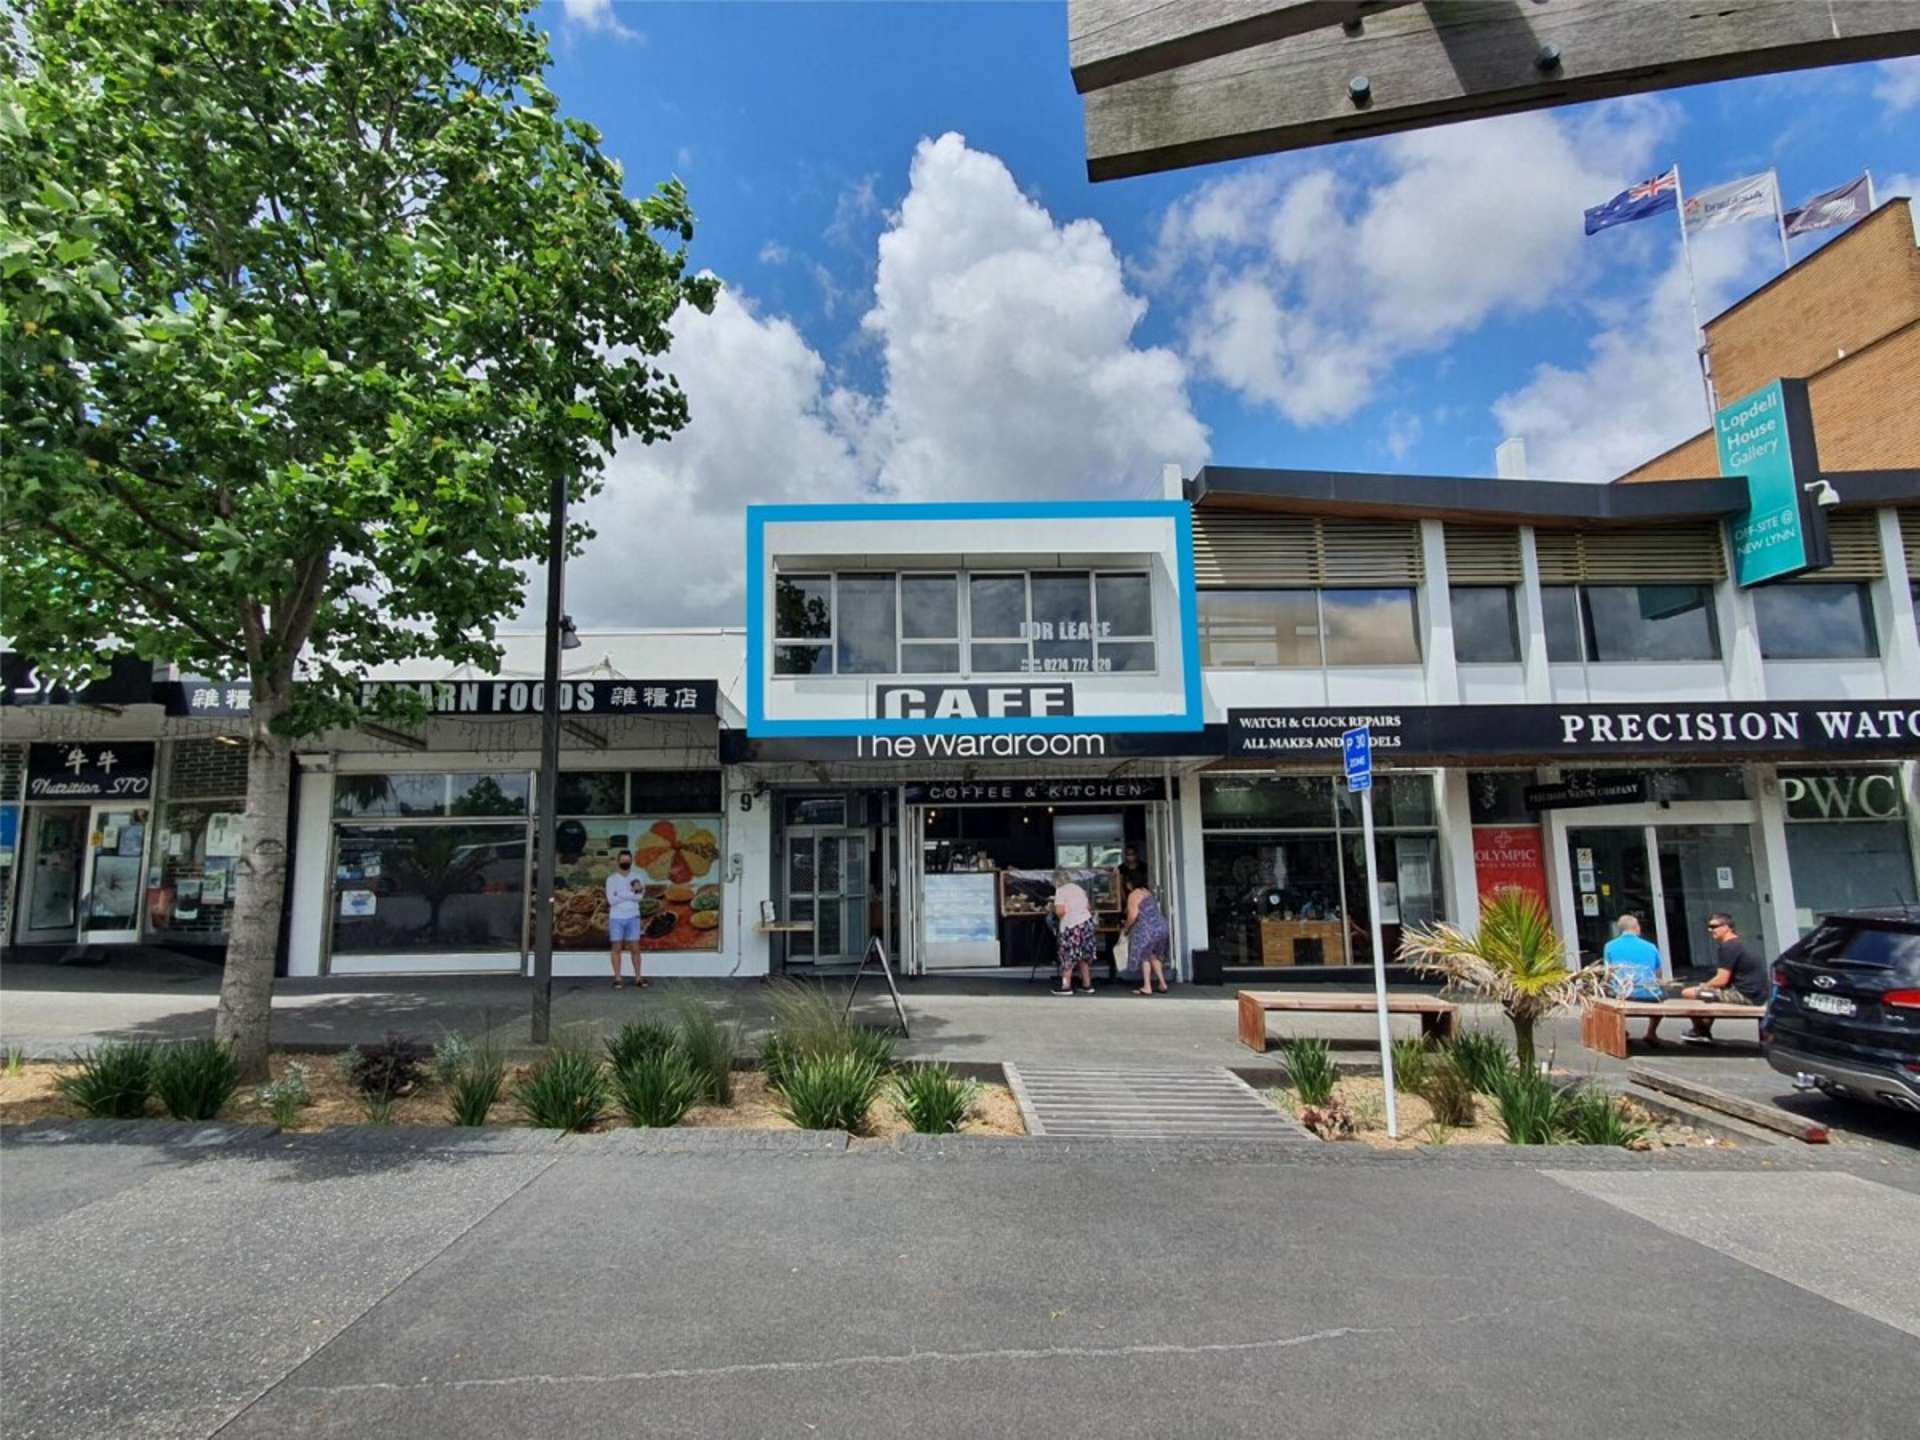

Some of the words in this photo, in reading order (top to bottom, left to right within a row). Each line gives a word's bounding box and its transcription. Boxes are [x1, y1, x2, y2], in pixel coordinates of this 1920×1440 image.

[1720, 392, 1777, 432] Lopdell
[1727, 419, 1777, 450] House
[1730, 438, 1778, 468] Gallery
[1735, 516, 1779, 541] OFF-SITE
[1737, 539, 1763, 557] NEW
[1765, 528, 1796, 547] LYNN
[492, 682, 595, 712] FOODS
[1240, 717, 1287, 728] WATCH
[1289, 717, 1299, 728] &
[1302, 716, 1346, 728] CLOCK
[1349, 715, 1401, 727] REPAIRS
[1560, 712, 1799, 743] PRECISION
[857, 734, 915, 757] The
[922, 733, 1105, 757] Wardroom
[1243, 738, 1268, 749] ALL
[1270, 738, 1313, 749] MAKES
[1315, 737, 1343, 748] AND
[1370, 736, 1401, 747] DELS
[31, 777, 101, 794] Nutrition
[106, 777, 149, 794] STO
[929, 786, 1012, 799] COFFEE
[1025, 785, 1036, 798] &
[1047, 783, 1142, 798] KITCHEN
[1778, 774, 1901, 819] PWC
[740, 792, 753, 813] 9
[1474, 848, 1537, 861] OLYMPIC
